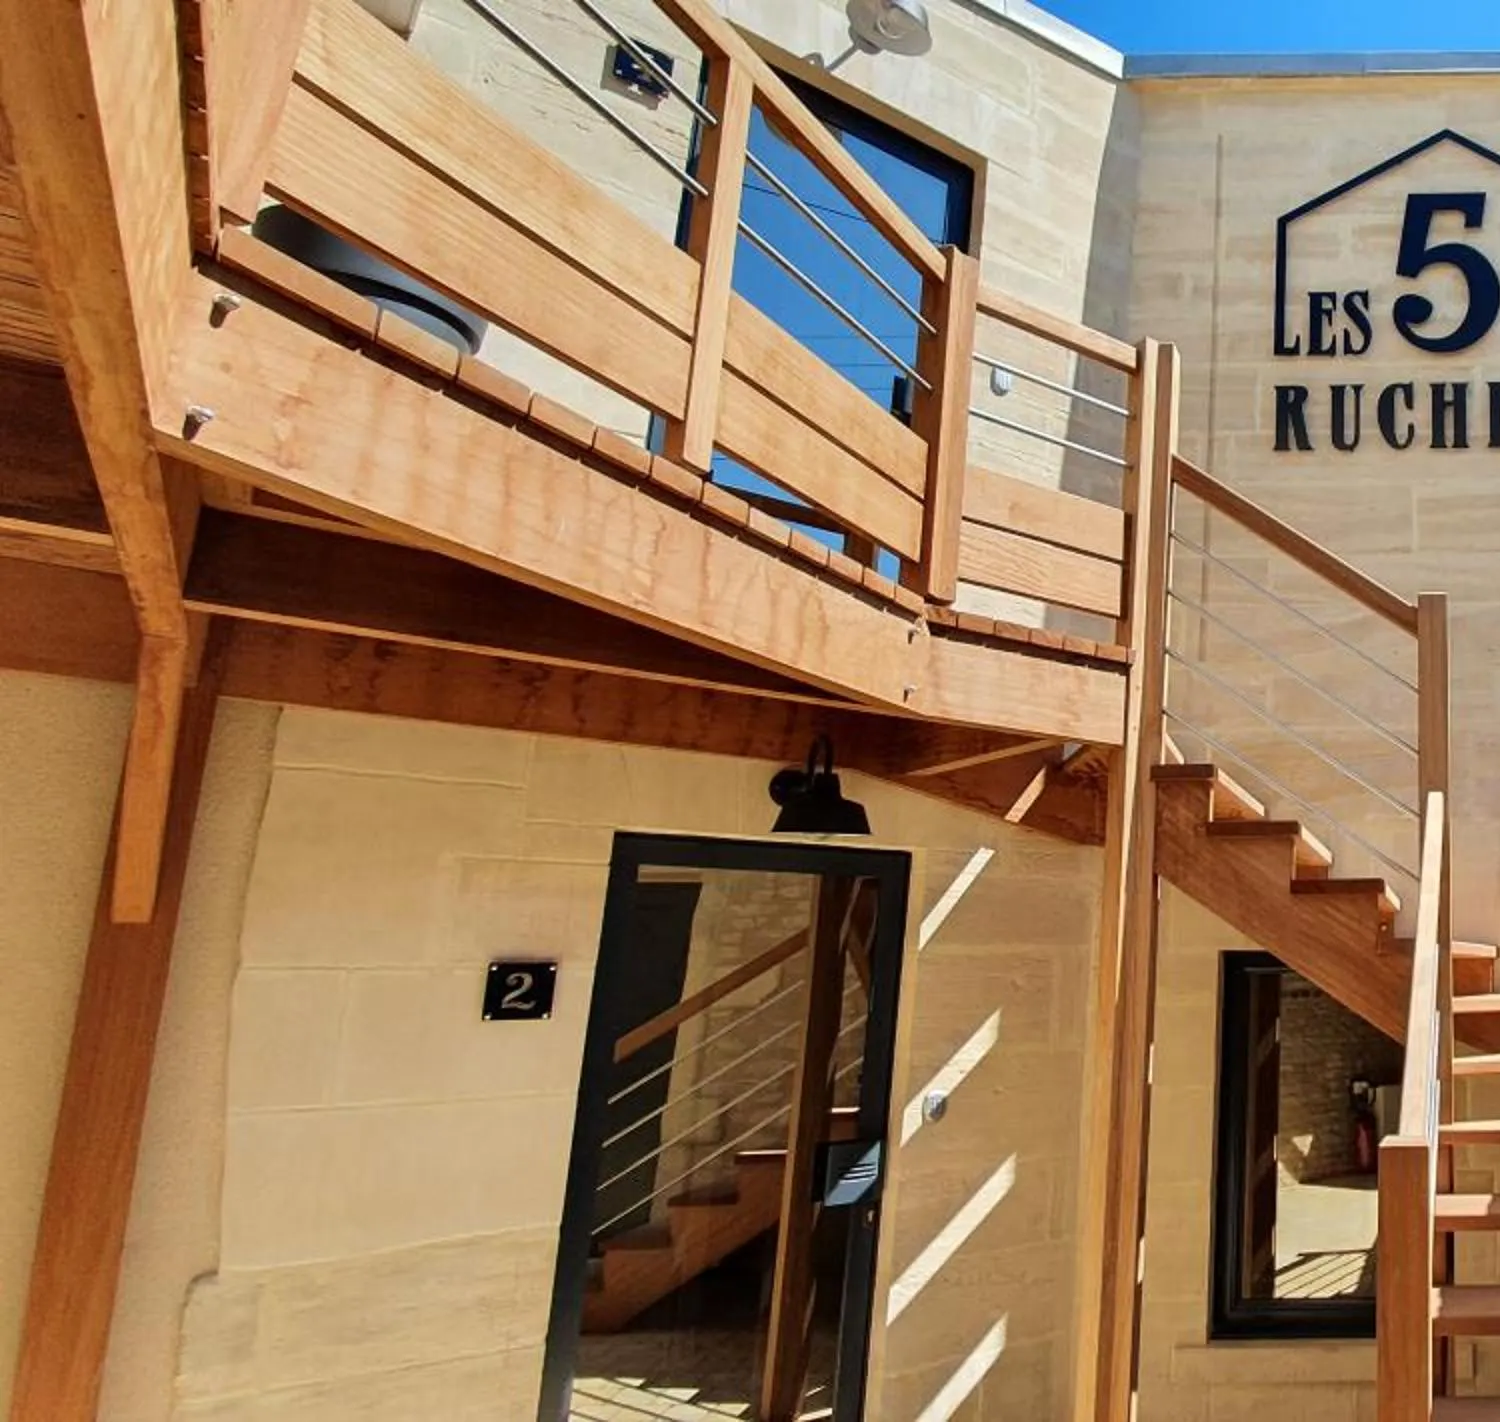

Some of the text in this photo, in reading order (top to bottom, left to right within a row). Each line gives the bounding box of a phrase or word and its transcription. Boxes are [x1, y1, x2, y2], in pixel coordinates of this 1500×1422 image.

[1273, 191, 1500, 357] LES 5
[501, 972, 537, 1011] 2
